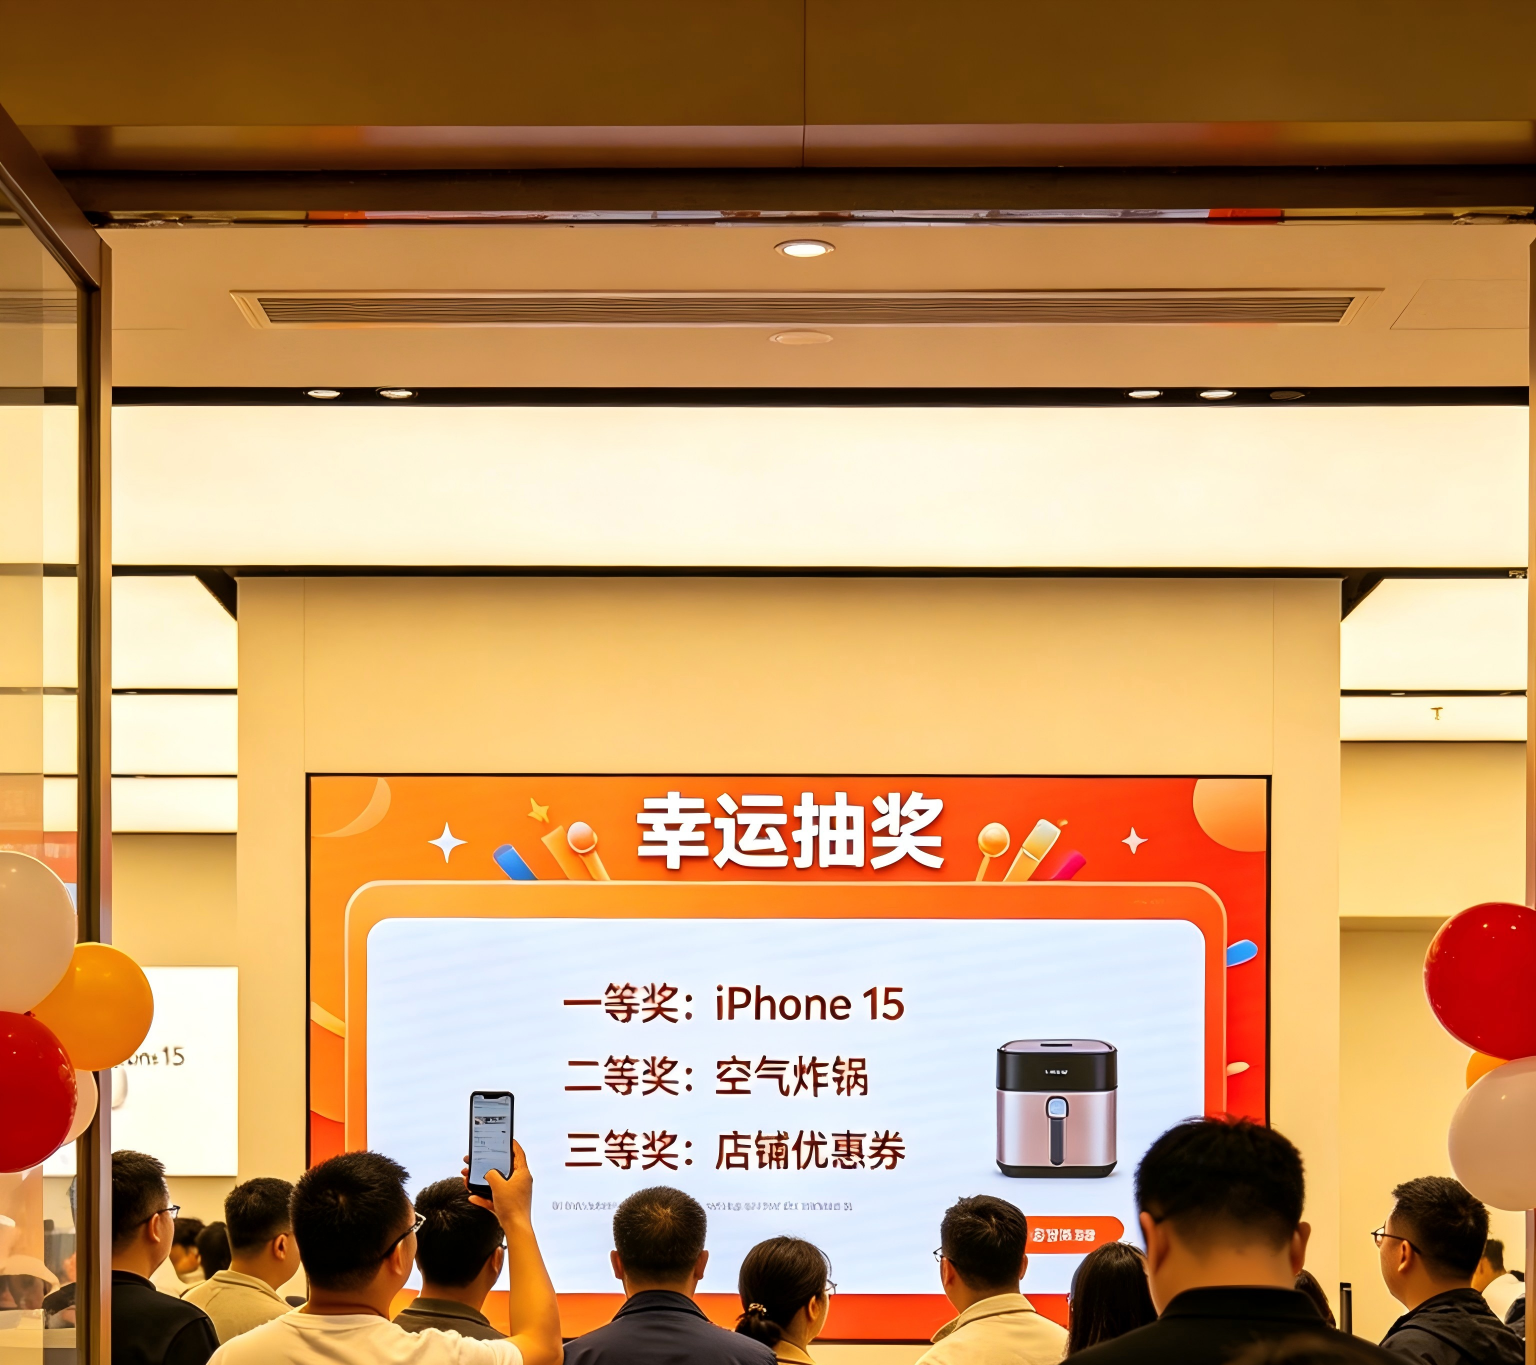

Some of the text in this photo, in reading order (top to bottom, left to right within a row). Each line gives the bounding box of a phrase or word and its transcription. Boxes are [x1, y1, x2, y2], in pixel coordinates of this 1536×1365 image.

[636, 791, 945, 870] 幸运抽奖
[716, 984, 852, 1021] iPhone
[862, 986, 905, 1021] 15
[162, 1046, 185, 1066] 15
